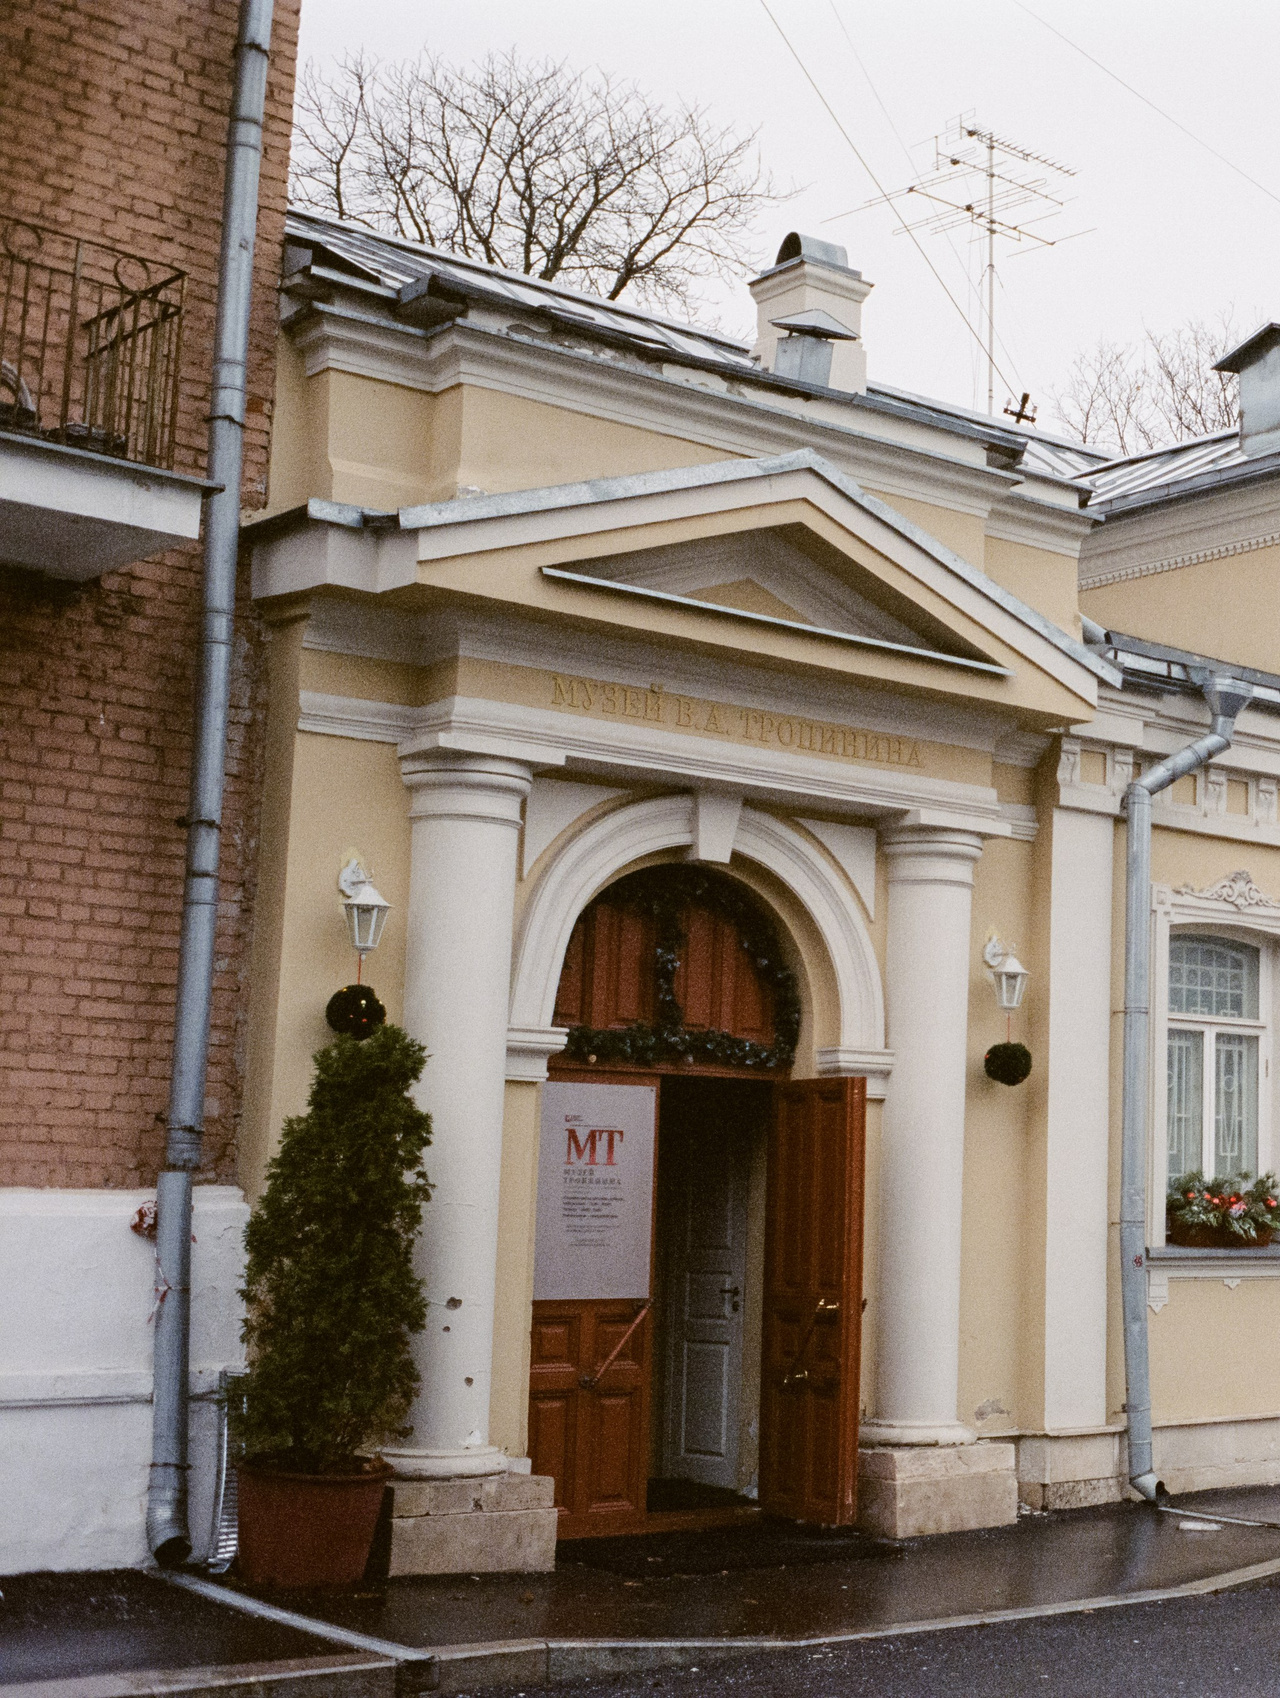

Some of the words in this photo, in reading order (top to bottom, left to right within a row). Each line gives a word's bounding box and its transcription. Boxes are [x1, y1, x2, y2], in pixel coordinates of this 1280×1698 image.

[551, 676, 665, 723] МУЗЕЙ
[676, 698, 731, 735] В.А.
[739, 710, 925, 768] ТРОПИНИНА
[564, 1128, 624, 1166] МТ
